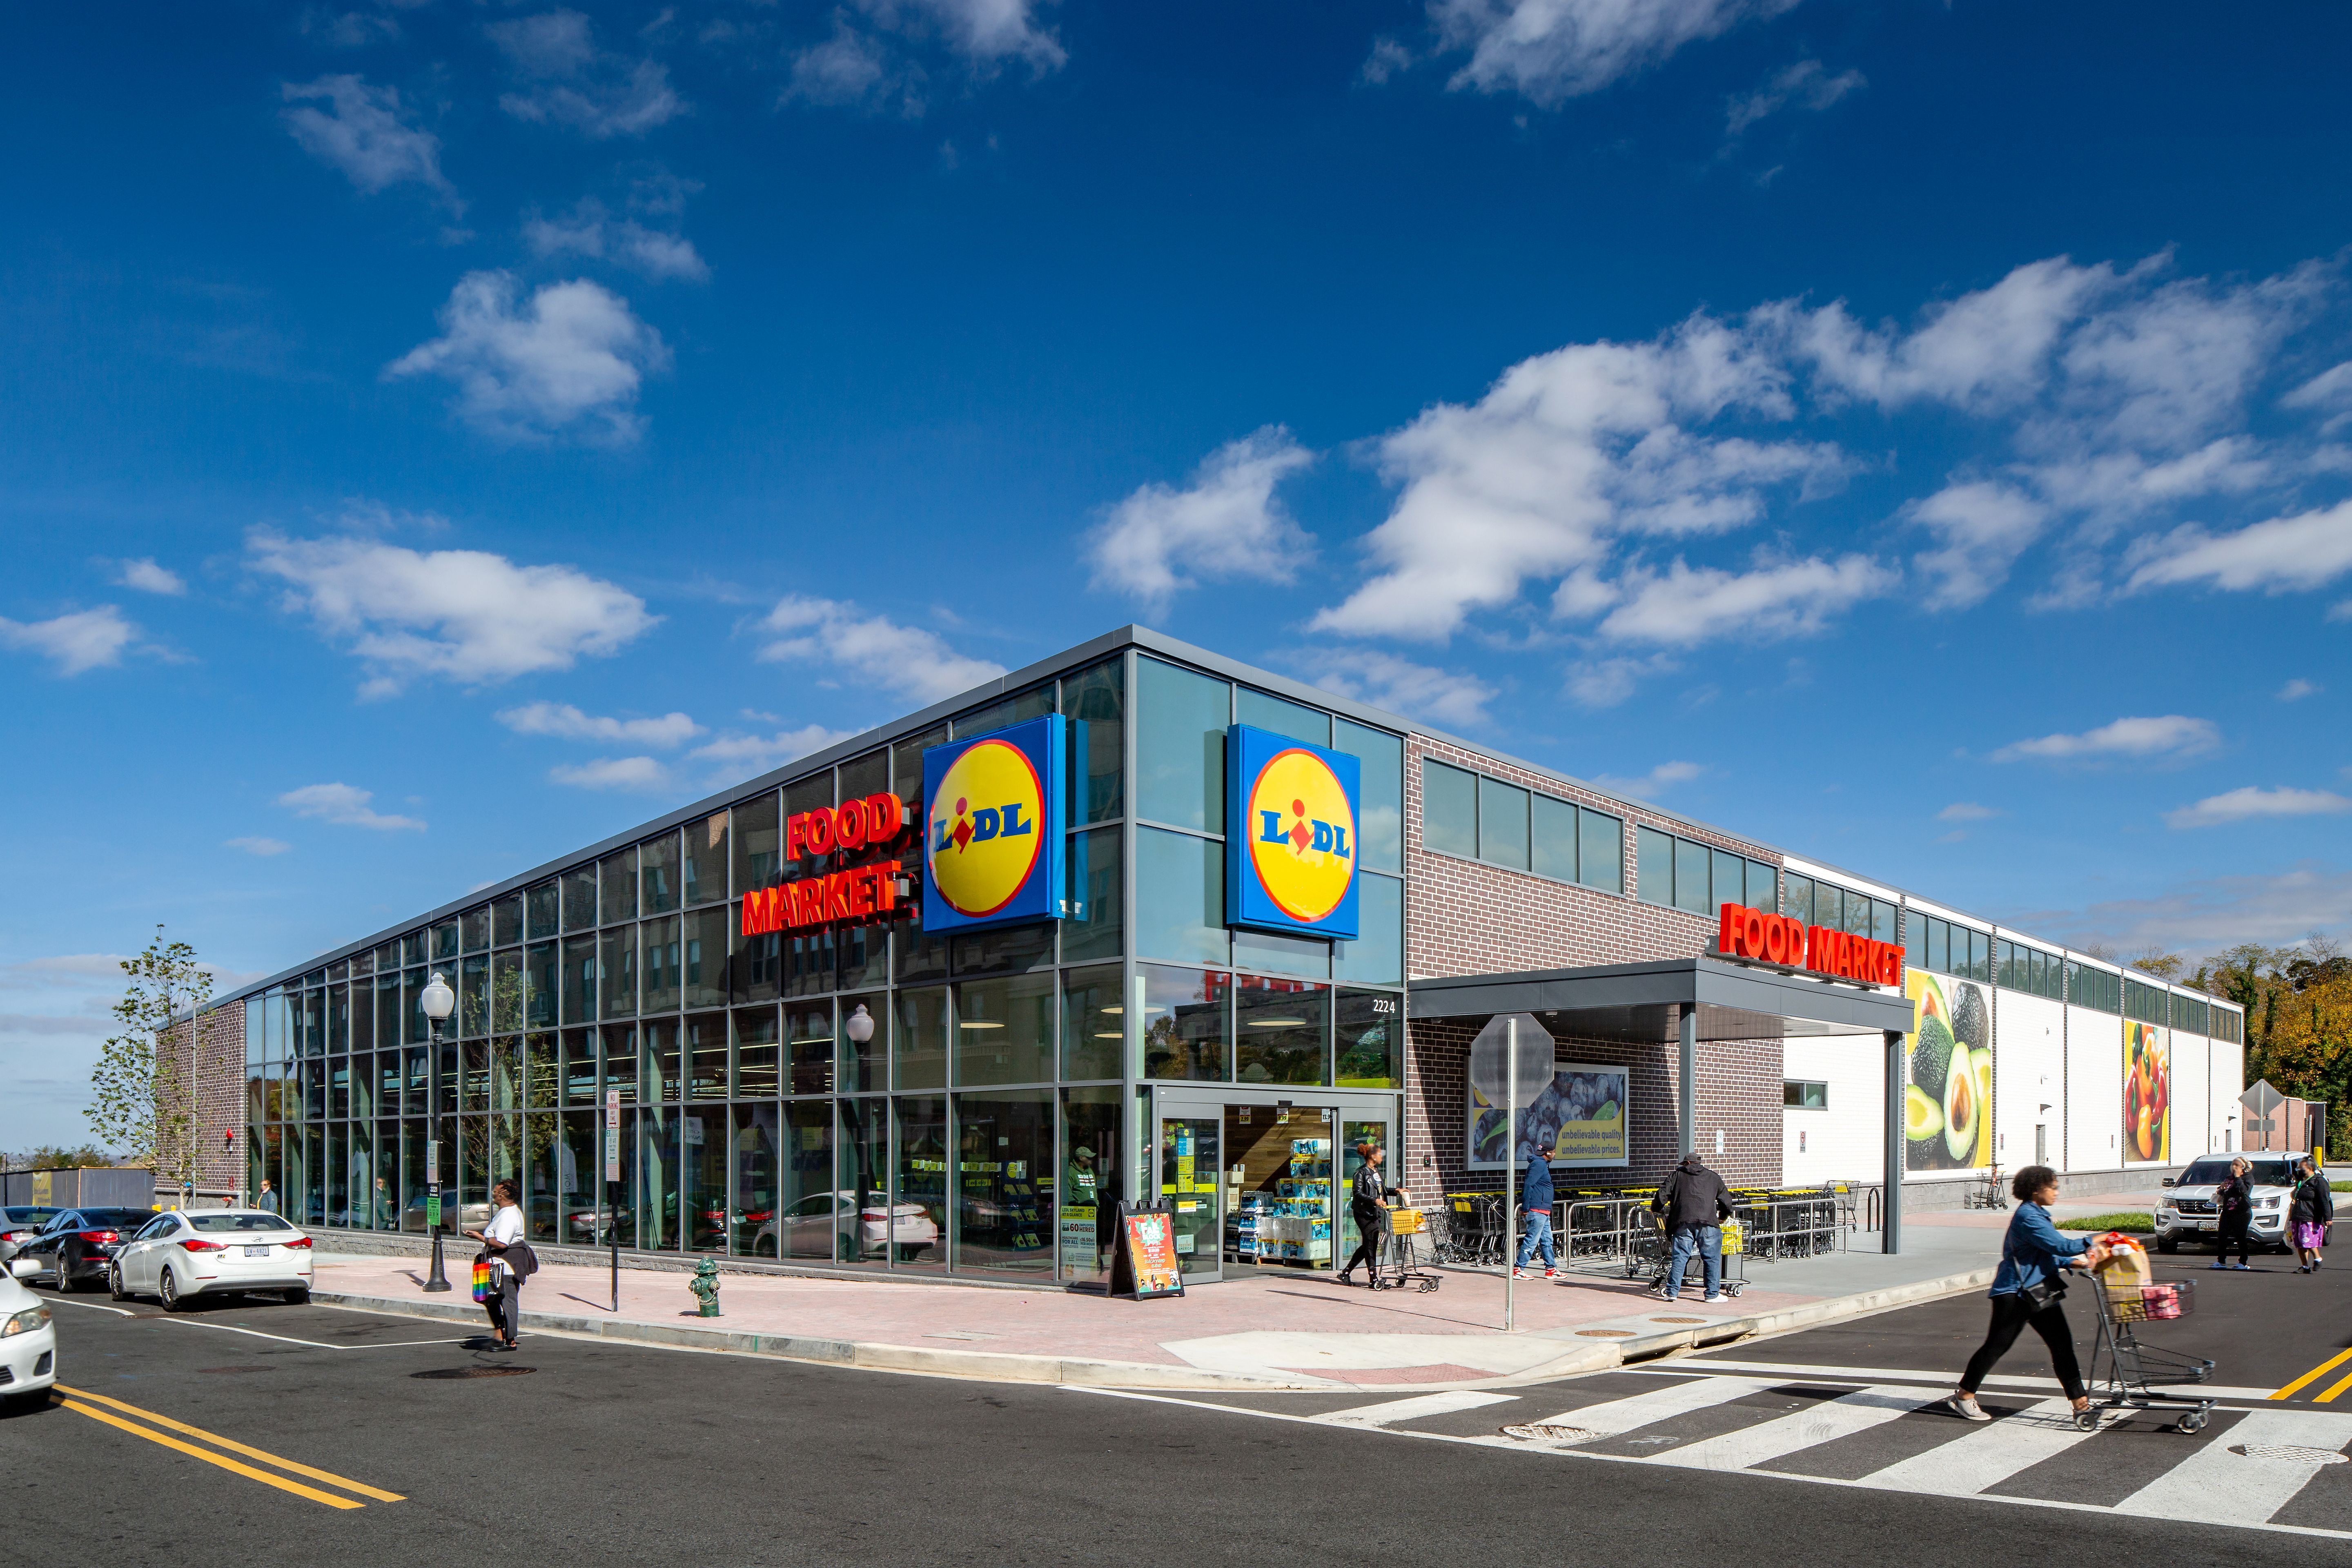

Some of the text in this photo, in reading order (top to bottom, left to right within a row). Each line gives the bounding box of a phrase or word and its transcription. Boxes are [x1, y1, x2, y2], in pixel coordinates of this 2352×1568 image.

[787, 792, 902, 861] FOOD
[742, 860, 901, 936] MARKET
[1719, 902, 1905, 987] FOOD MARKET
[1373, 999, 1395, 1013] 2224
[1562, 1129, 1622, 1141] unbelievable quality.
[1562, 1144, 1621, 1156] unbelievable prices.
[1070, 1223, 1079, 1232] 60
